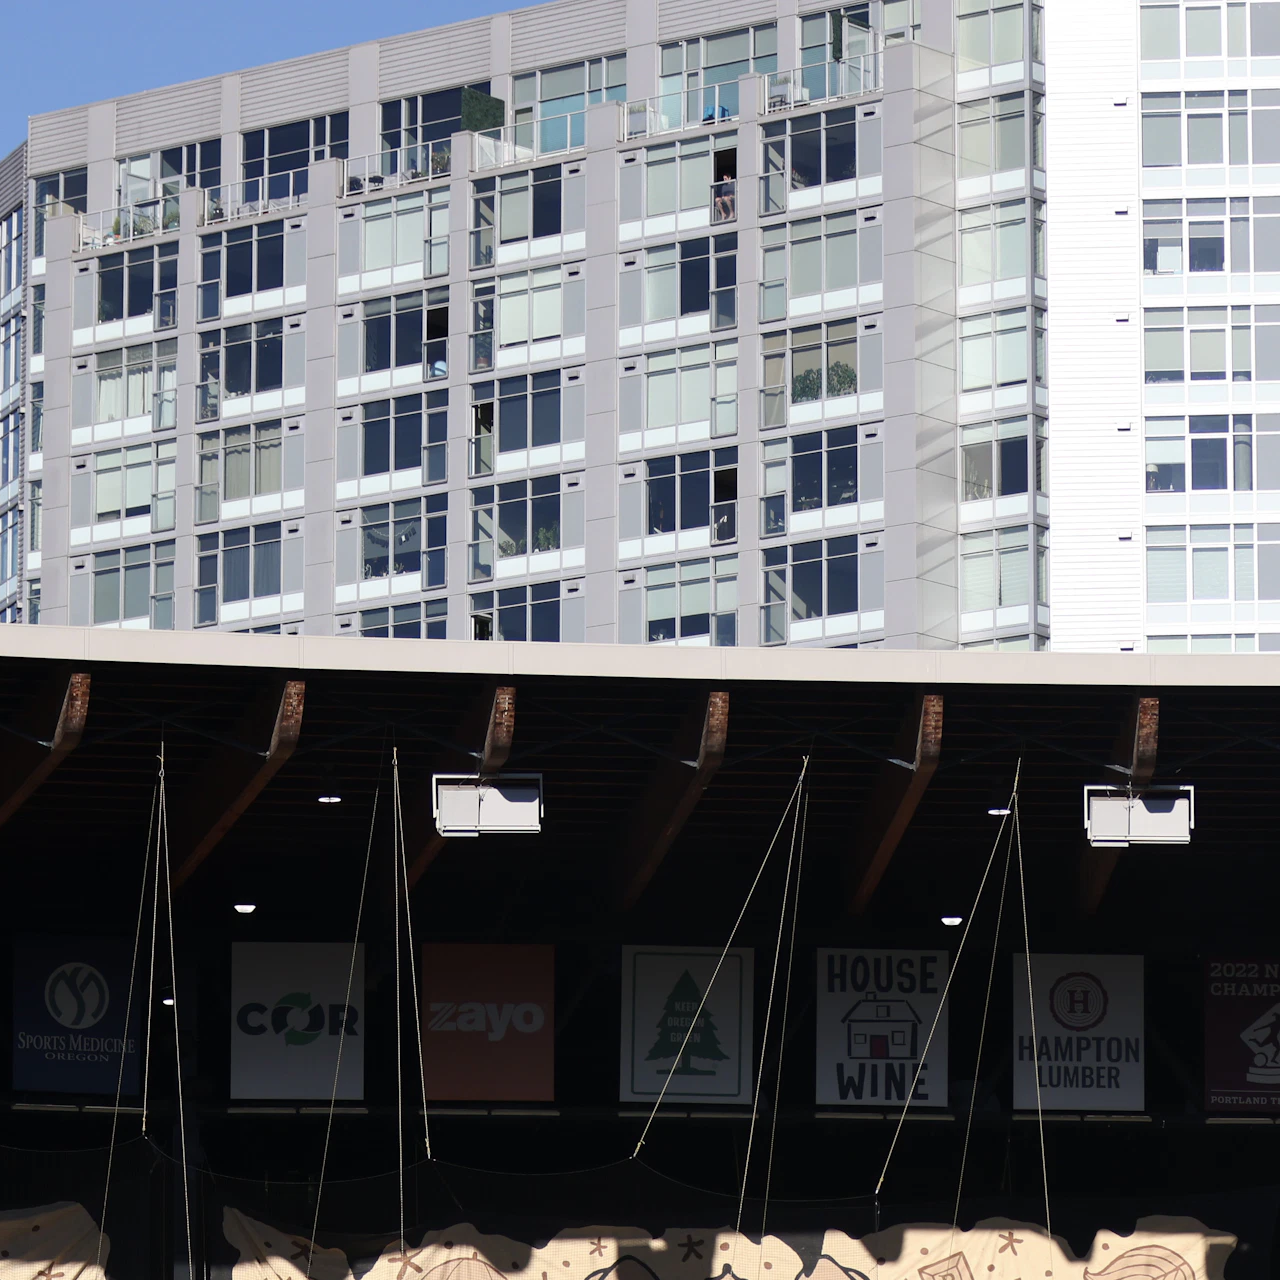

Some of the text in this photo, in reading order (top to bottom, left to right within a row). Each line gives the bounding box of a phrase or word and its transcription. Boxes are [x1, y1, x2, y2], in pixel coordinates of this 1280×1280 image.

[827, 954, 938, 994] HOUSE
[1210, 962, 1259, 979] 2022
[674, 1002, 700, 1012] KEEP
[1067, 989, 1091, 1014] H
[17, 1032, 136, 1055] SPORTS MEDICINE
[1019, 1035, 1140, 1063] HAMPTON
[45, 1051, 109, 1063] OREGON
[836, 1062, 929, 1100] WINE
[1038, 1065, 1120, 1089] LUMBER
[1210, 1096, 1267, 1106] PORTLAND
